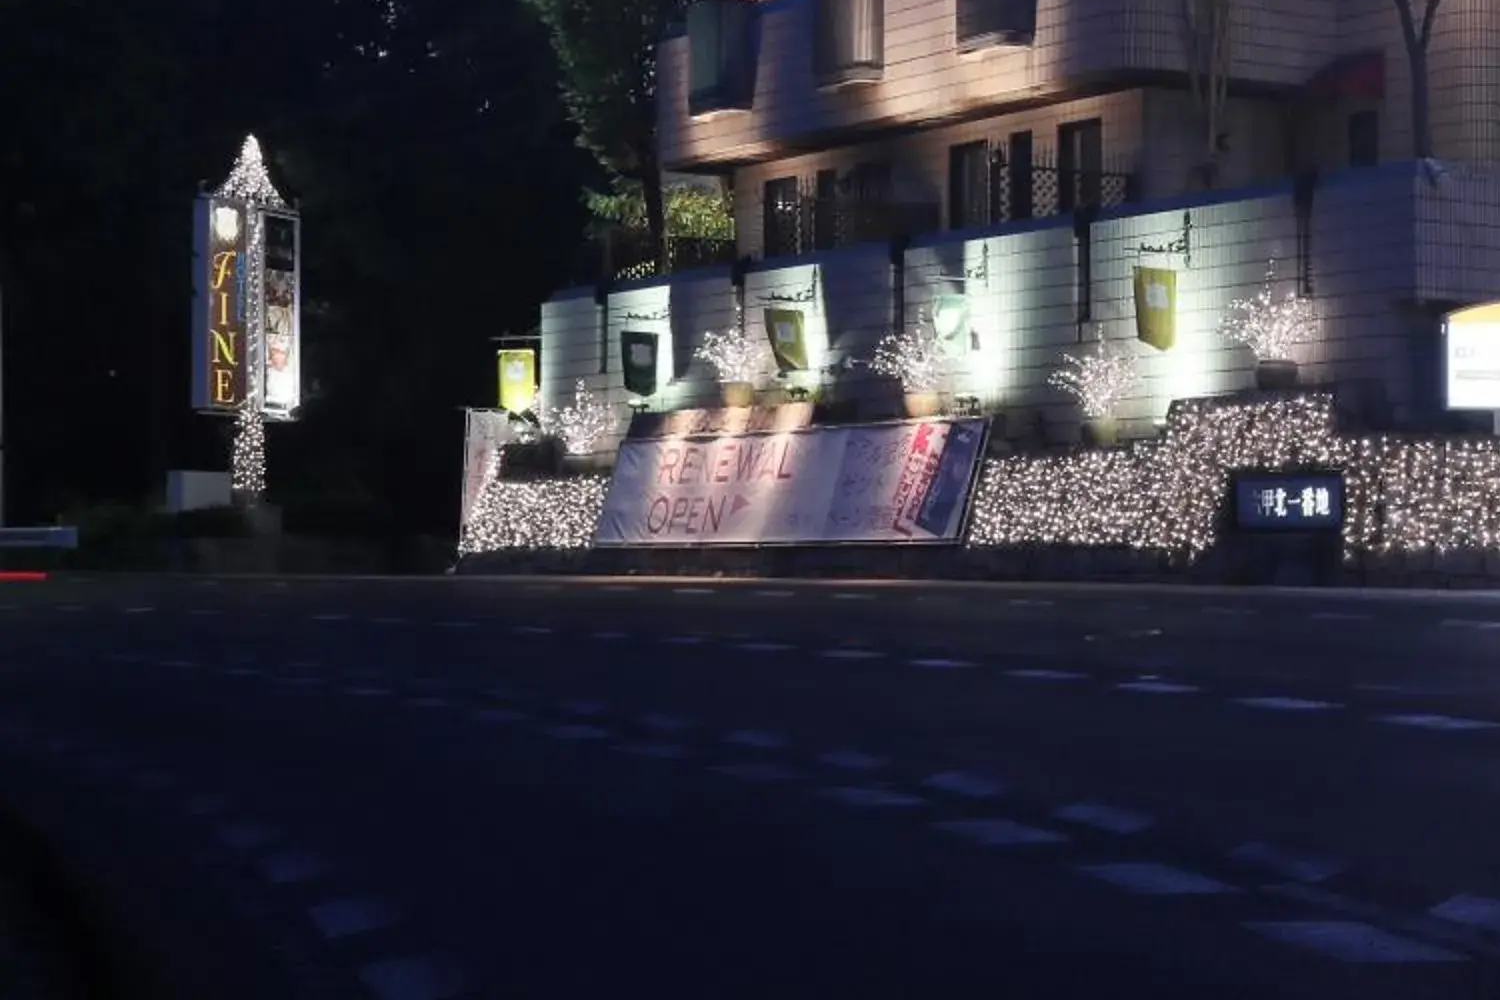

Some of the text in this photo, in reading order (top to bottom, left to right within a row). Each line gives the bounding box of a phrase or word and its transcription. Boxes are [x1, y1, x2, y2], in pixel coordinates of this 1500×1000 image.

[210, 250, 239, 403] FINE
[657, 441, 792, 485] RENEWAL
[647, 495, 727, 535] OPEN
